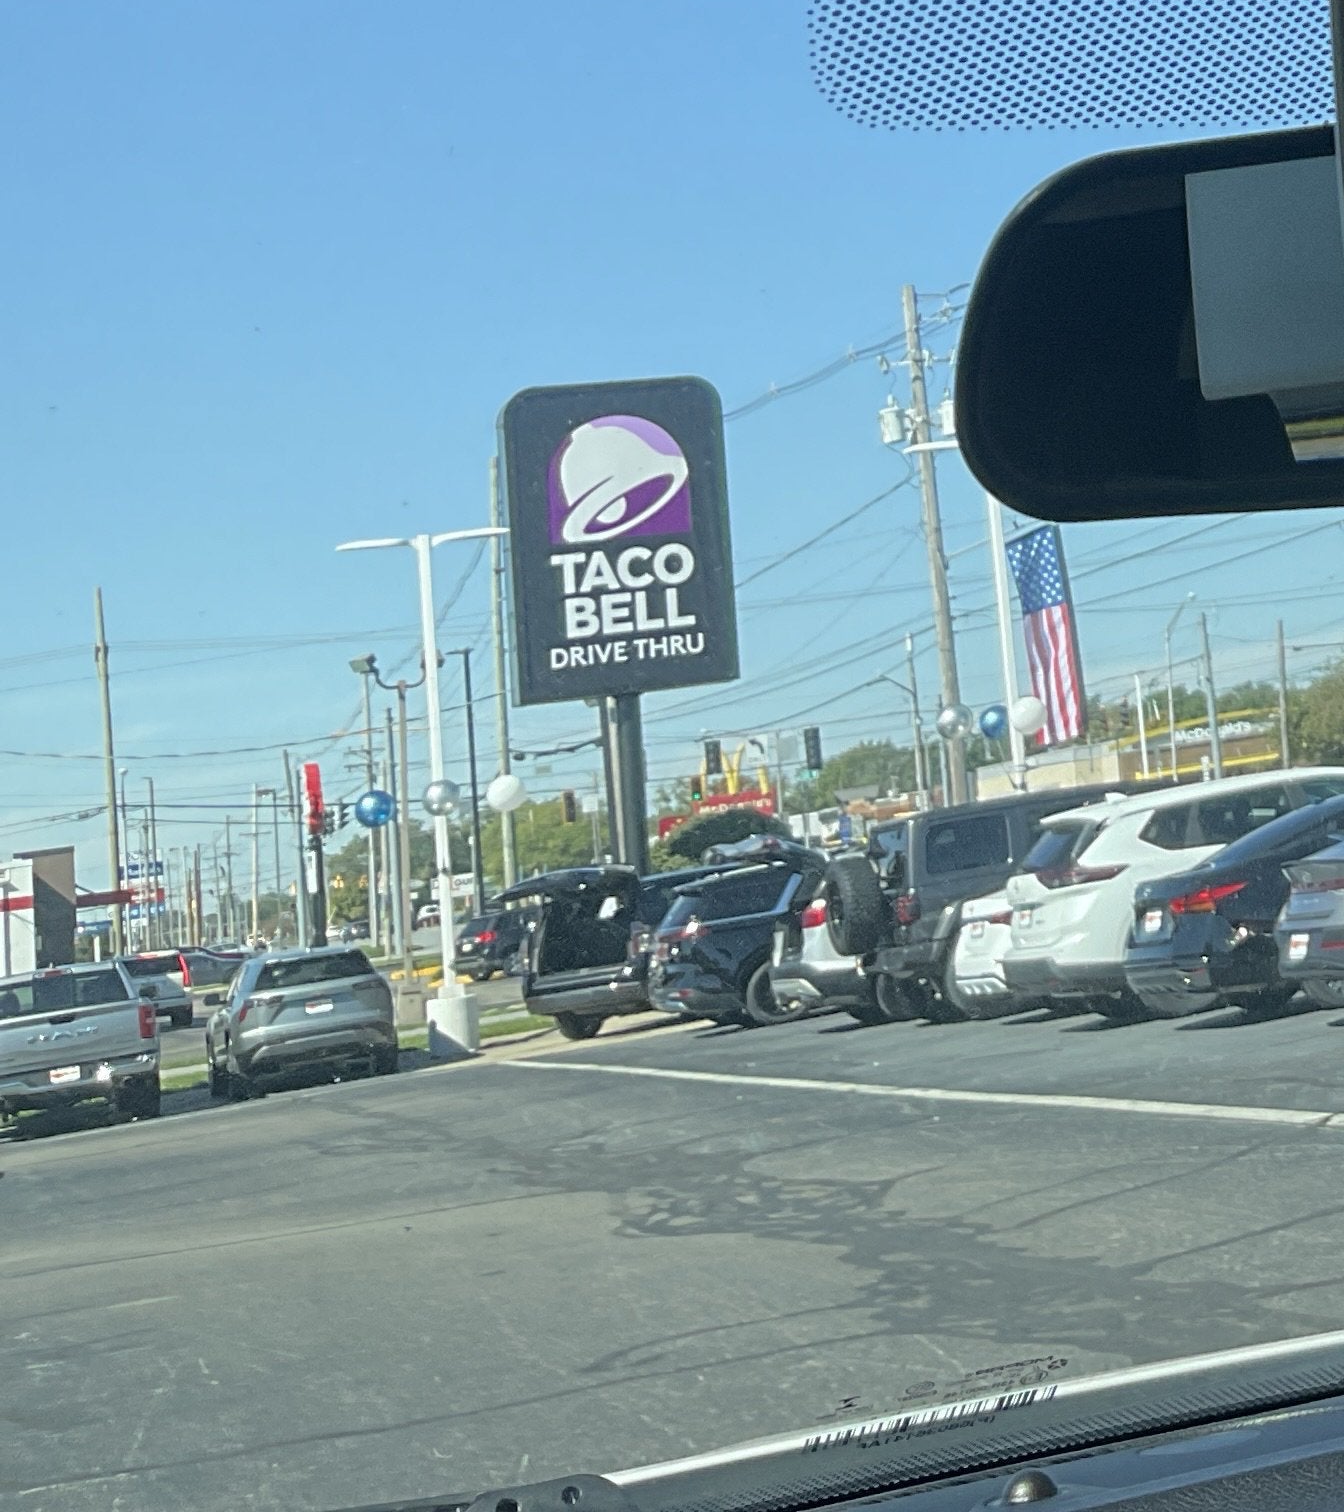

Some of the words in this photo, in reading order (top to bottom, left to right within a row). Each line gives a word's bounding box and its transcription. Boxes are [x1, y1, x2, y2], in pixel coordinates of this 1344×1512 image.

[550, 542, 696, 594] TACO
[565, 587, 696, 639] BELL
[550, 641, 629, 670] DRIVE
[633, 632, 705, 662] THRU
[1173, 720, 1252, 743] McDoald's
